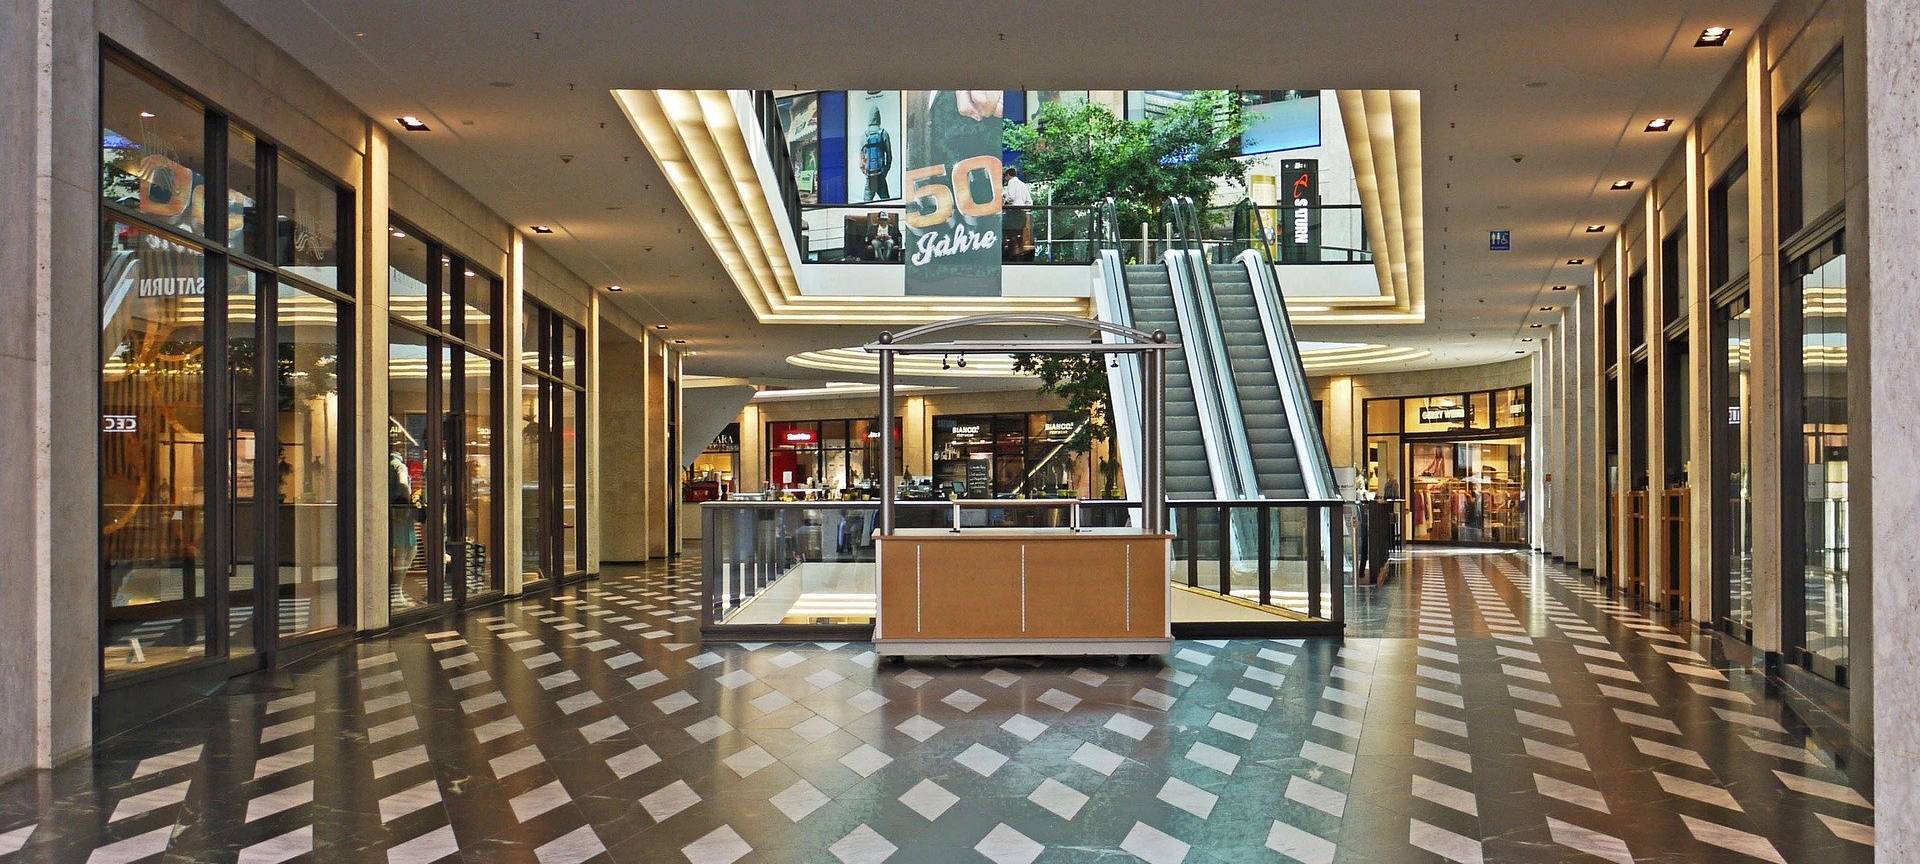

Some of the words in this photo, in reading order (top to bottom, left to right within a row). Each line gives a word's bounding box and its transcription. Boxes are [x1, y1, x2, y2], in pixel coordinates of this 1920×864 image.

[906, 155, 1003, 229] 50
[1294, 198, 1309, 244] STURN
[911, 223, 998, 266] Jahre
